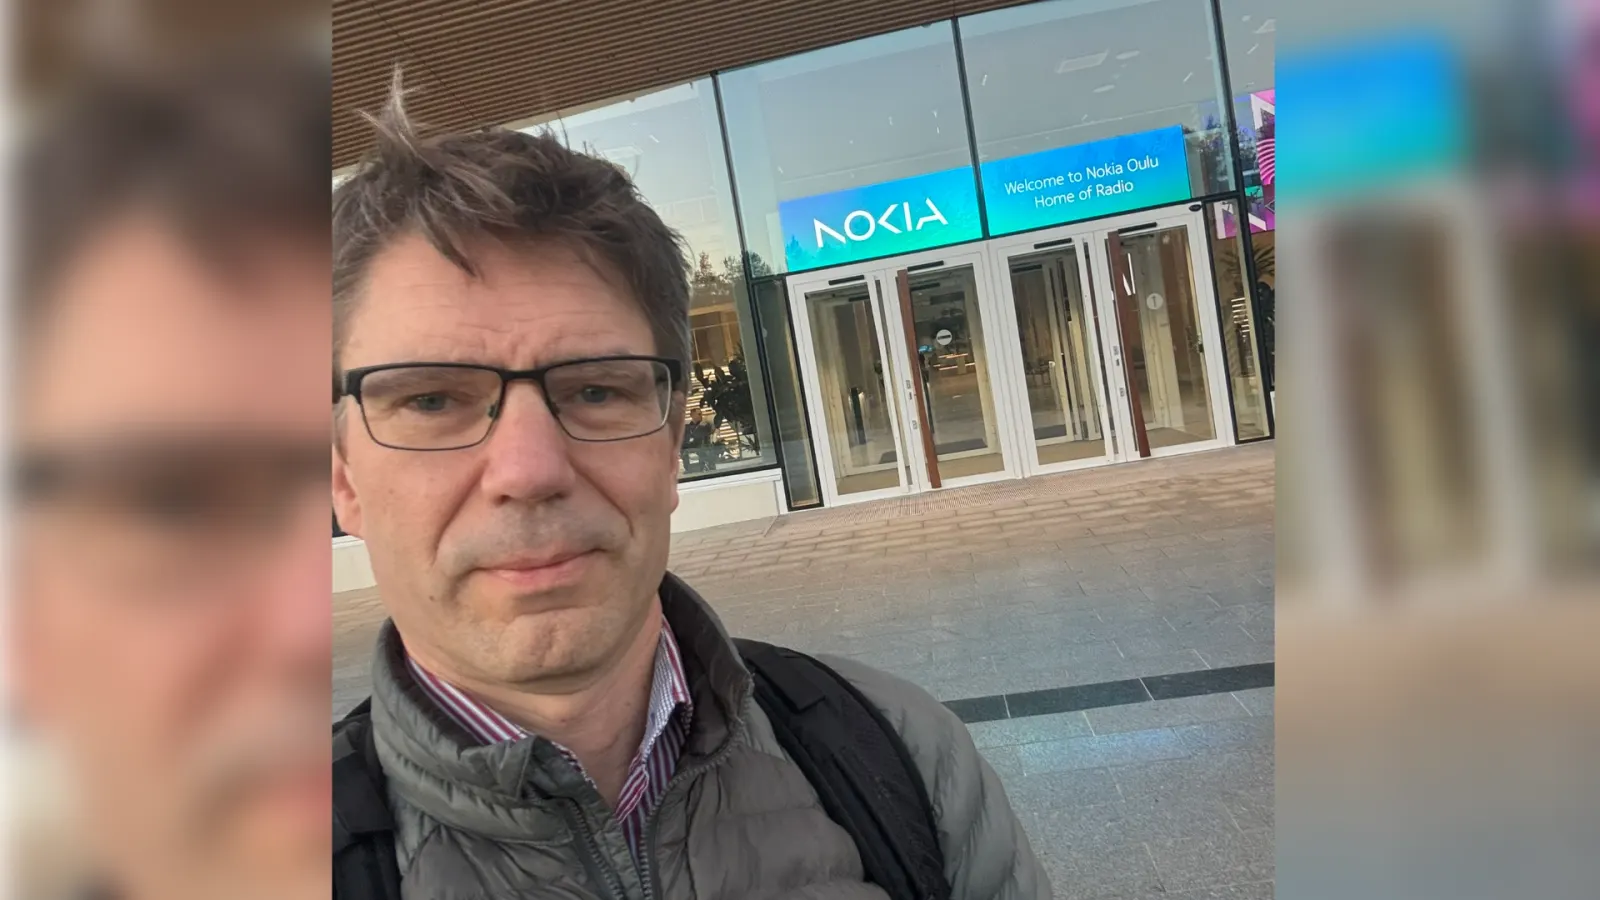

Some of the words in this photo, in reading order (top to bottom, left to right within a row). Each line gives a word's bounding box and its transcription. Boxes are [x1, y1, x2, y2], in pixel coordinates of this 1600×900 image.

[1004, 175, 1064, 195] Welcome
[1068, 171, 1083, 182] to
[1086, 163, 1123, 179] Nokia
[1127, 155, 1159, 172] Oulu
[1035, 193, 1075, 208] Home
[1079, 185, 1093, 200] of
[1097, 180, 1134, 196] Radio
[813, 198, 948, 248] NOKIA
